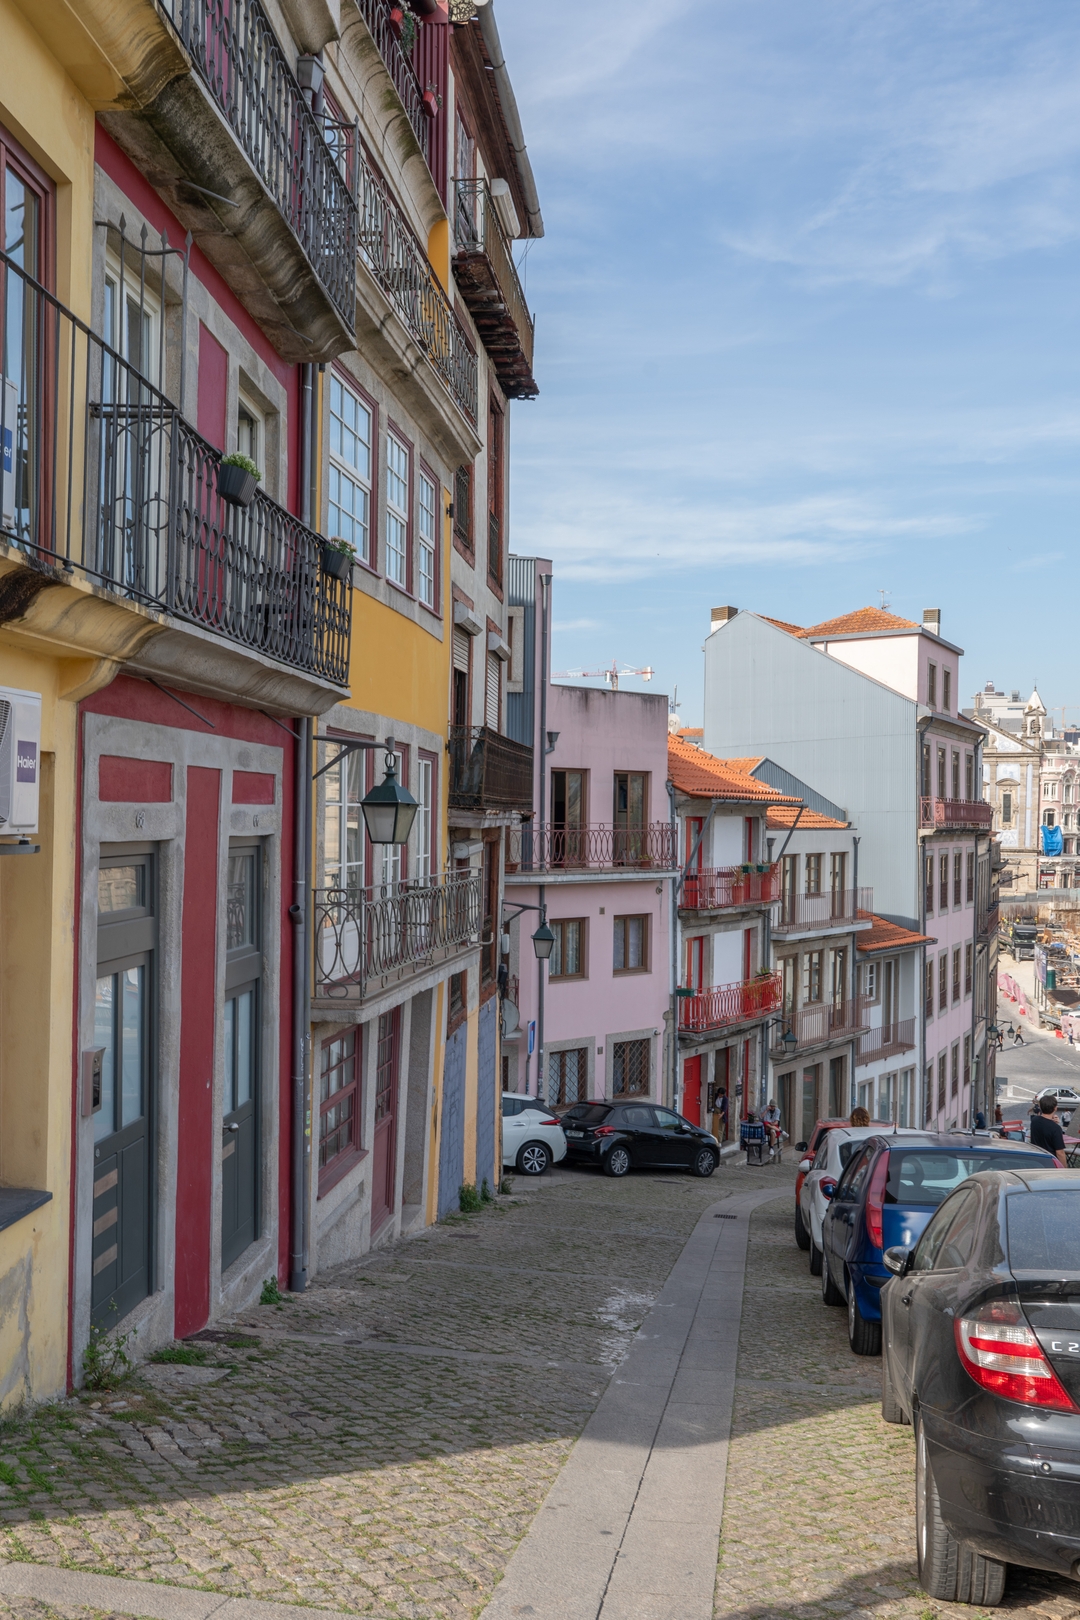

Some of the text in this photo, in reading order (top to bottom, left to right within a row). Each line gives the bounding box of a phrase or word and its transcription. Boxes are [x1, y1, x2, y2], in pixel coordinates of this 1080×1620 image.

[3, 446, 12, 458] er
[17, 755, 36, 769] Haier
[1051, 1341, 1080, 1353] C 2
